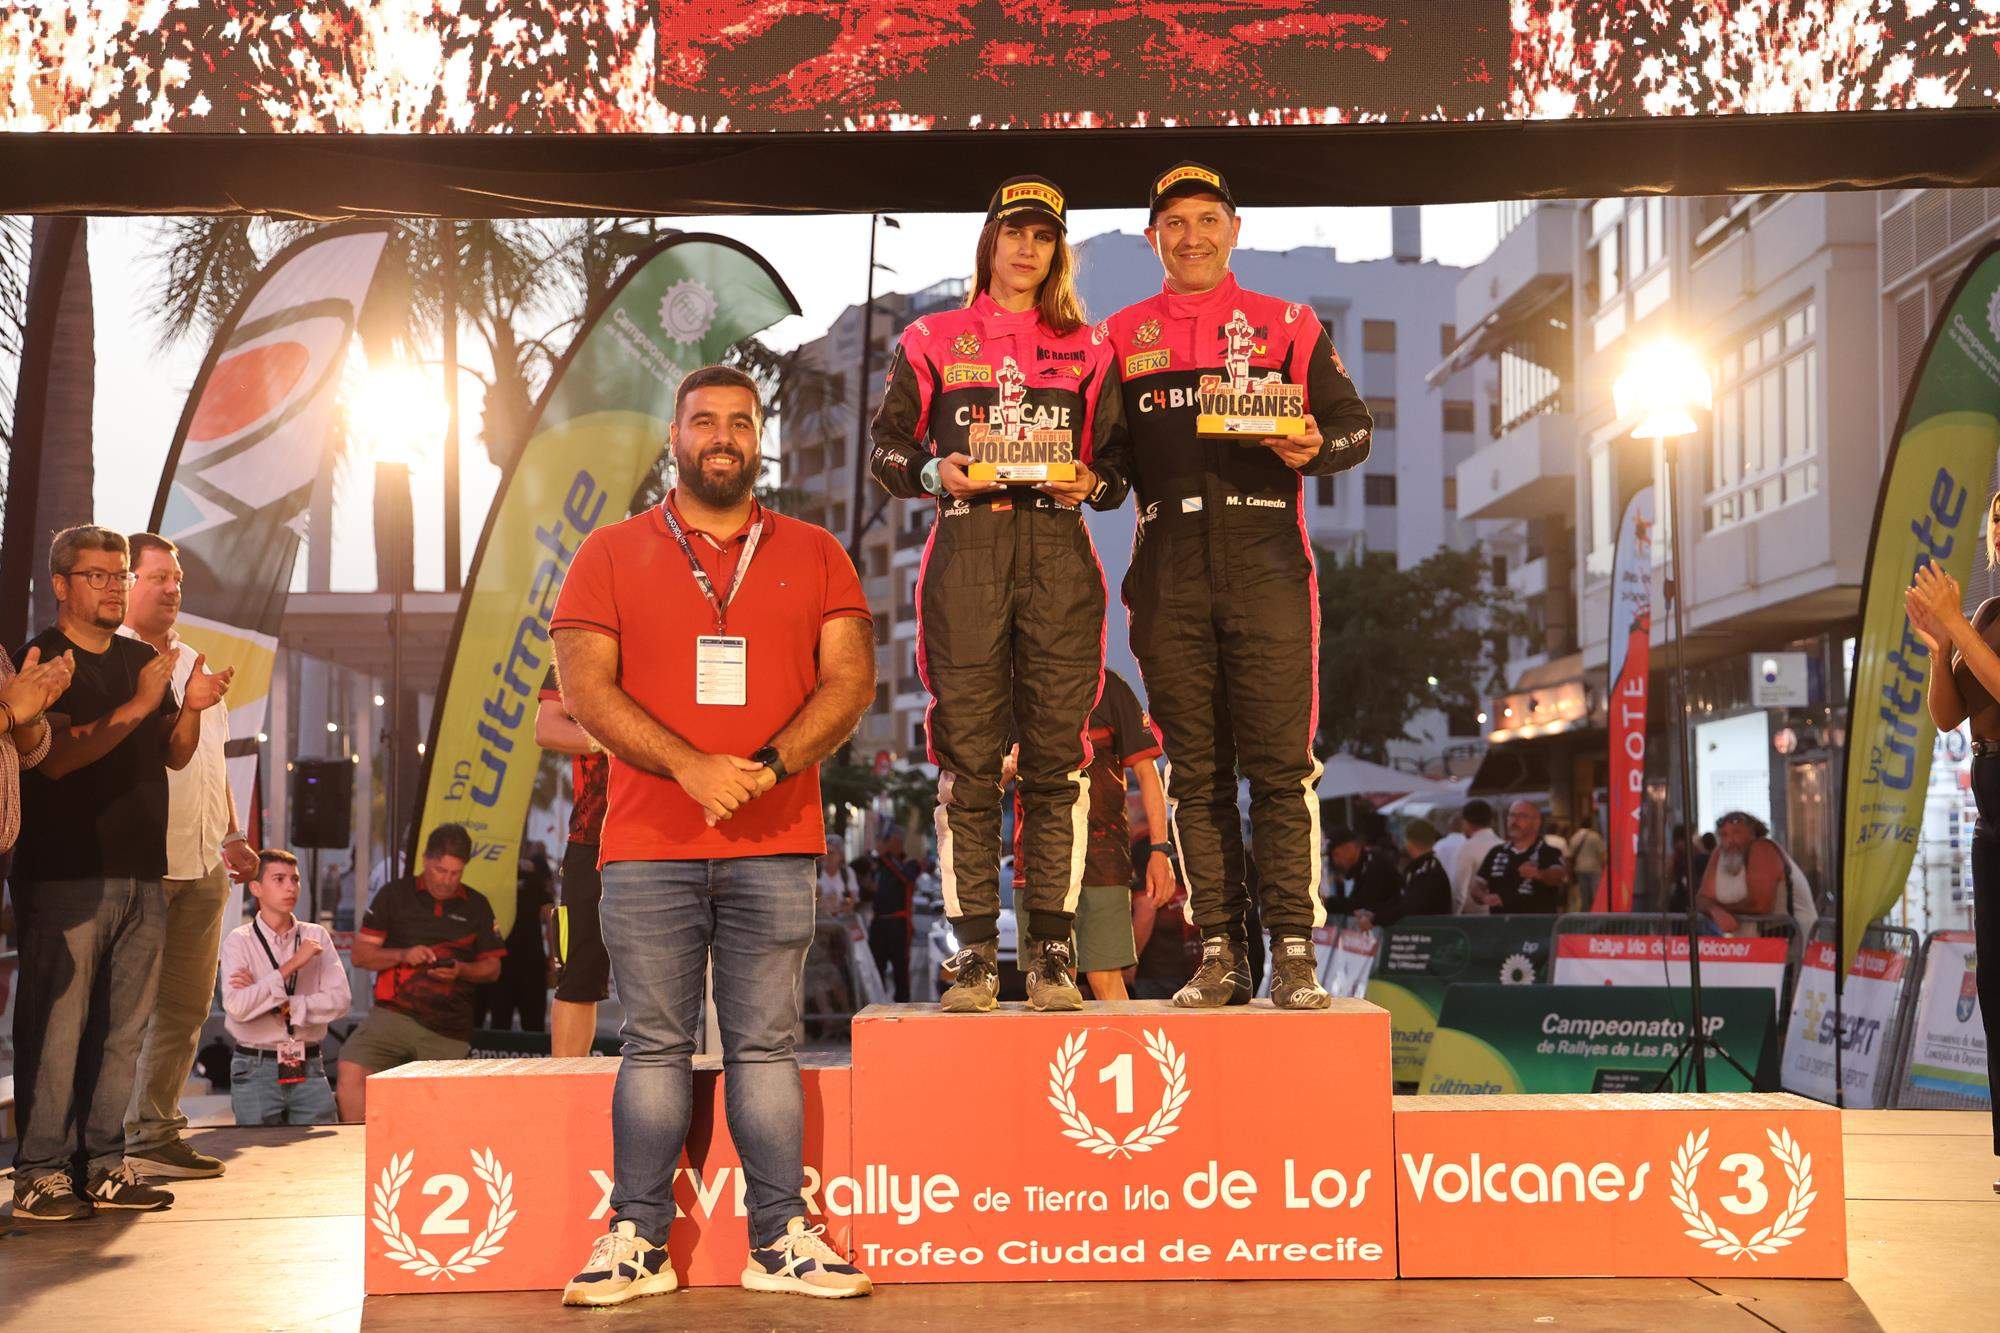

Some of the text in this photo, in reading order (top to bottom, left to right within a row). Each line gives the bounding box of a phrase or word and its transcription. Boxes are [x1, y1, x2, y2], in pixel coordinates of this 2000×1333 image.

[1161, 168, 1215, 189] PIRELLI
[1006, 184, 1061, 209] PIRELLI
[1052, 350, 1086, 363] RACING
[1128, 355, 1168, 374] GETXO
[946, 370, 989, 384] GETXO
[1200, 375, 1220, 394] 27
[1138, 388, 1200, 414] C4BI
[1201, 394, 1303, 418] VOLCANES
[955, 404, 1071, 428] C4BCAJE
[970, 441, 1072, 464] VOLCANES
[1225, 496, 1287, 509] M. Canedo
[1541, 1013, 1685, 1039] Campeonato
[1537, 1040, 1554, 1055] de
[1553, 1040, 1610, 1057] Rallyes
[1611, 1041, 1629, 1056] de
[1633, 1042, 1658, 1057] Las
[1099, 1053, 1134, 1113] 1
[973, 1186, 1011, 1212] de
[1024, 1185, 1107, 1213] Tierra
[1124, 1184, 1169, 1211] Isla
[1183, 1159, 1257, 1209] de
[1284, 1158, 1372, 1209] Los
[1401, 1151, 1651, 1204] Volcanes
[1718, 1153, 1767, 1215] 3
[420, 1173, 471, 1235] 2
[862, 1236, 1384, 1266] Trofeo Ciudad de Arrecife
